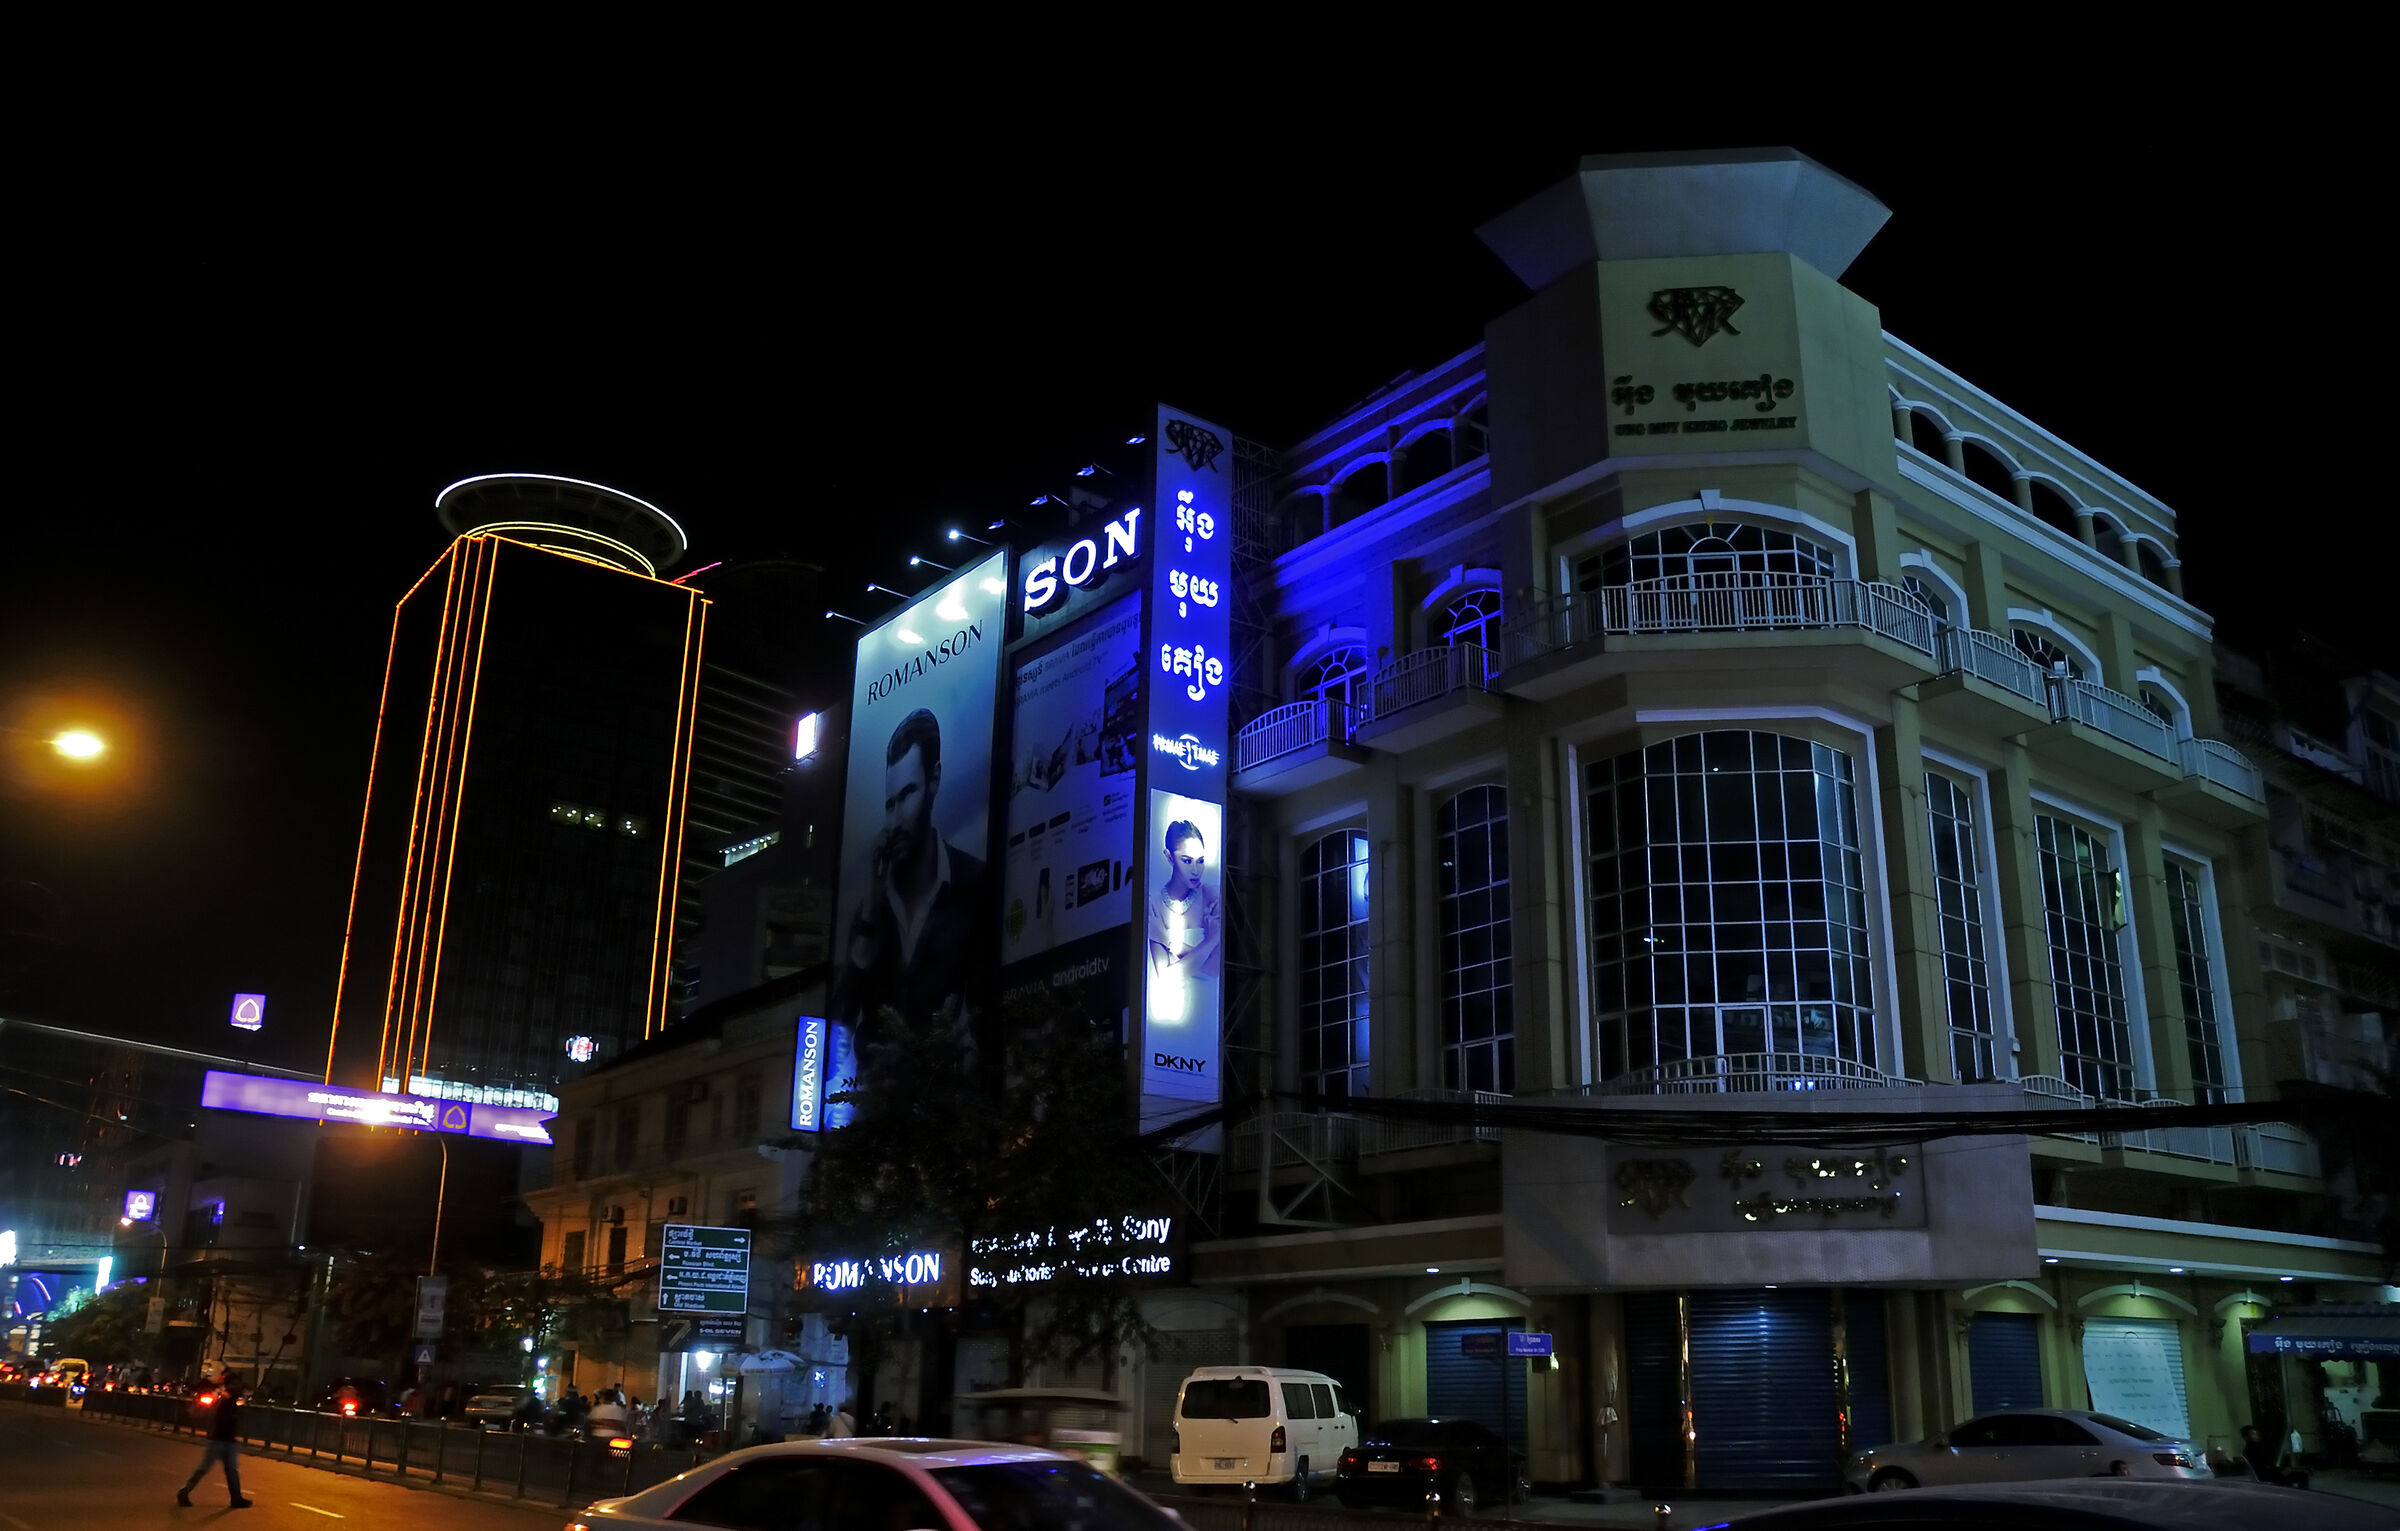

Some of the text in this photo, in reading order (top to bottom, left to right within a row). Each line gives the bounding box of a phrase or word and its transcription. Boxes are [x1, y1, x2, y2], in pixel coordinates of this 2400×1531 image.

[1169, 568, 1219, 619] មុយ
[868, 619, 983, 705] ROMANSON
[1161, 643, 1223, 701] គៀង
[799, 1021, 819, 1127] ROMANSON
[1154, 1052, 1207, 1073] DKNY
